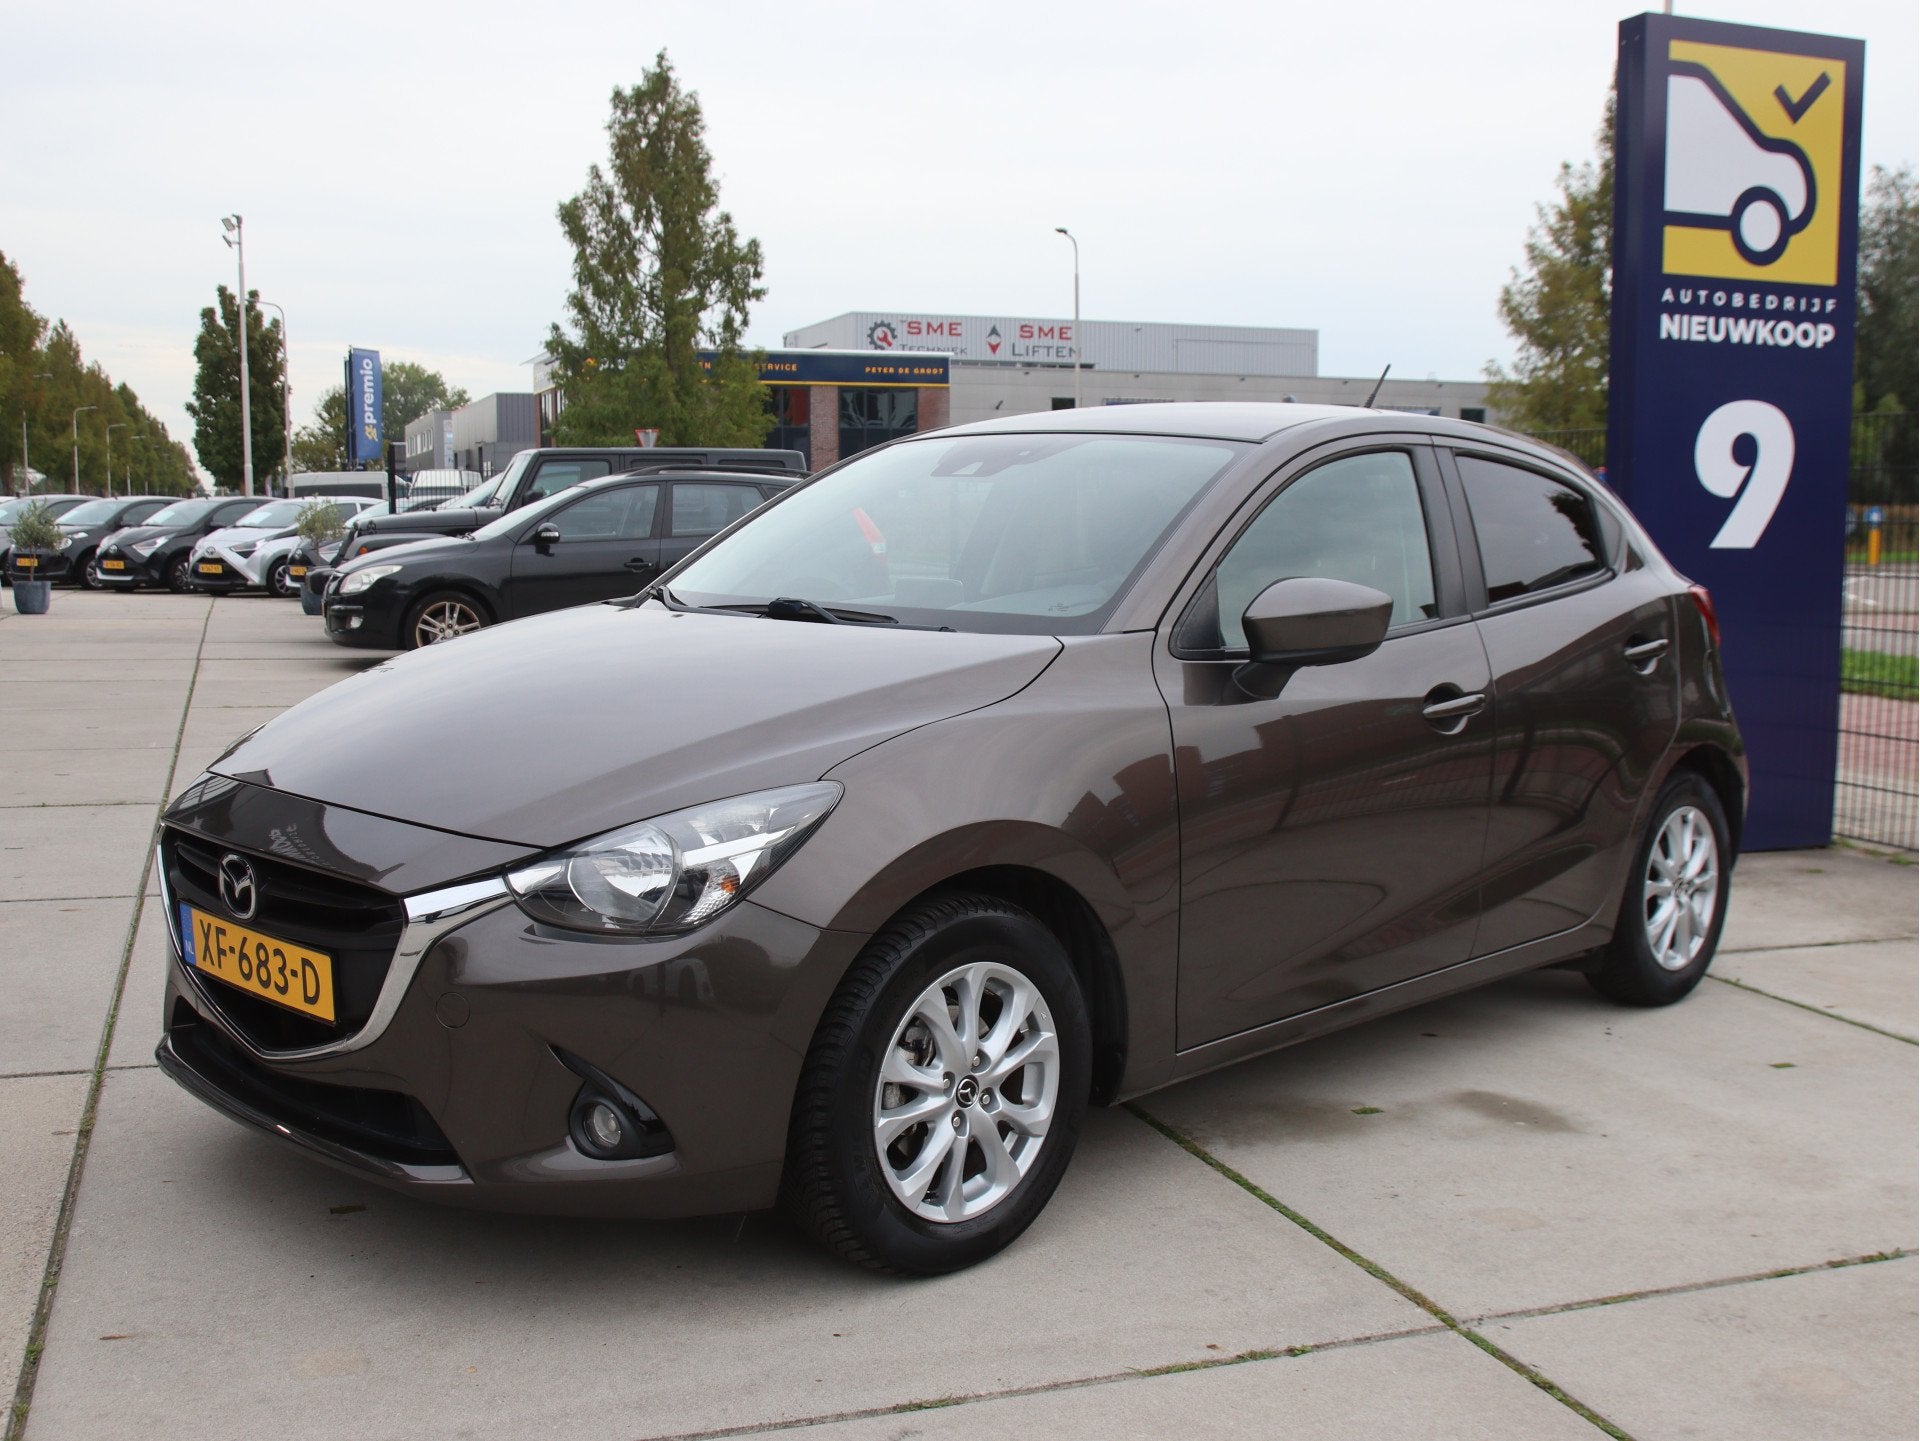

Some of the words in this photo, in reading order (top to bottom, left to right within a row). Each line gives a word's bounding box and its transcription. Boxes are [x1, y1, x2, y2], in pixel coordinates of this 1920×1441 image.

[1661, 287, 1837, 313] AUTOBEDRIJF
[907, 321, 962, 336] SME
[1019, 325, 1072, 340] SME
[1659, 313, 1836, 349] NIEUWKOOP
[865, 366, 895, 374] PETER
[361, 358, 376, 424] premio
[1694, 399, 1795, 549] 9
[200, 918, 321, 1006] XF-683-D
